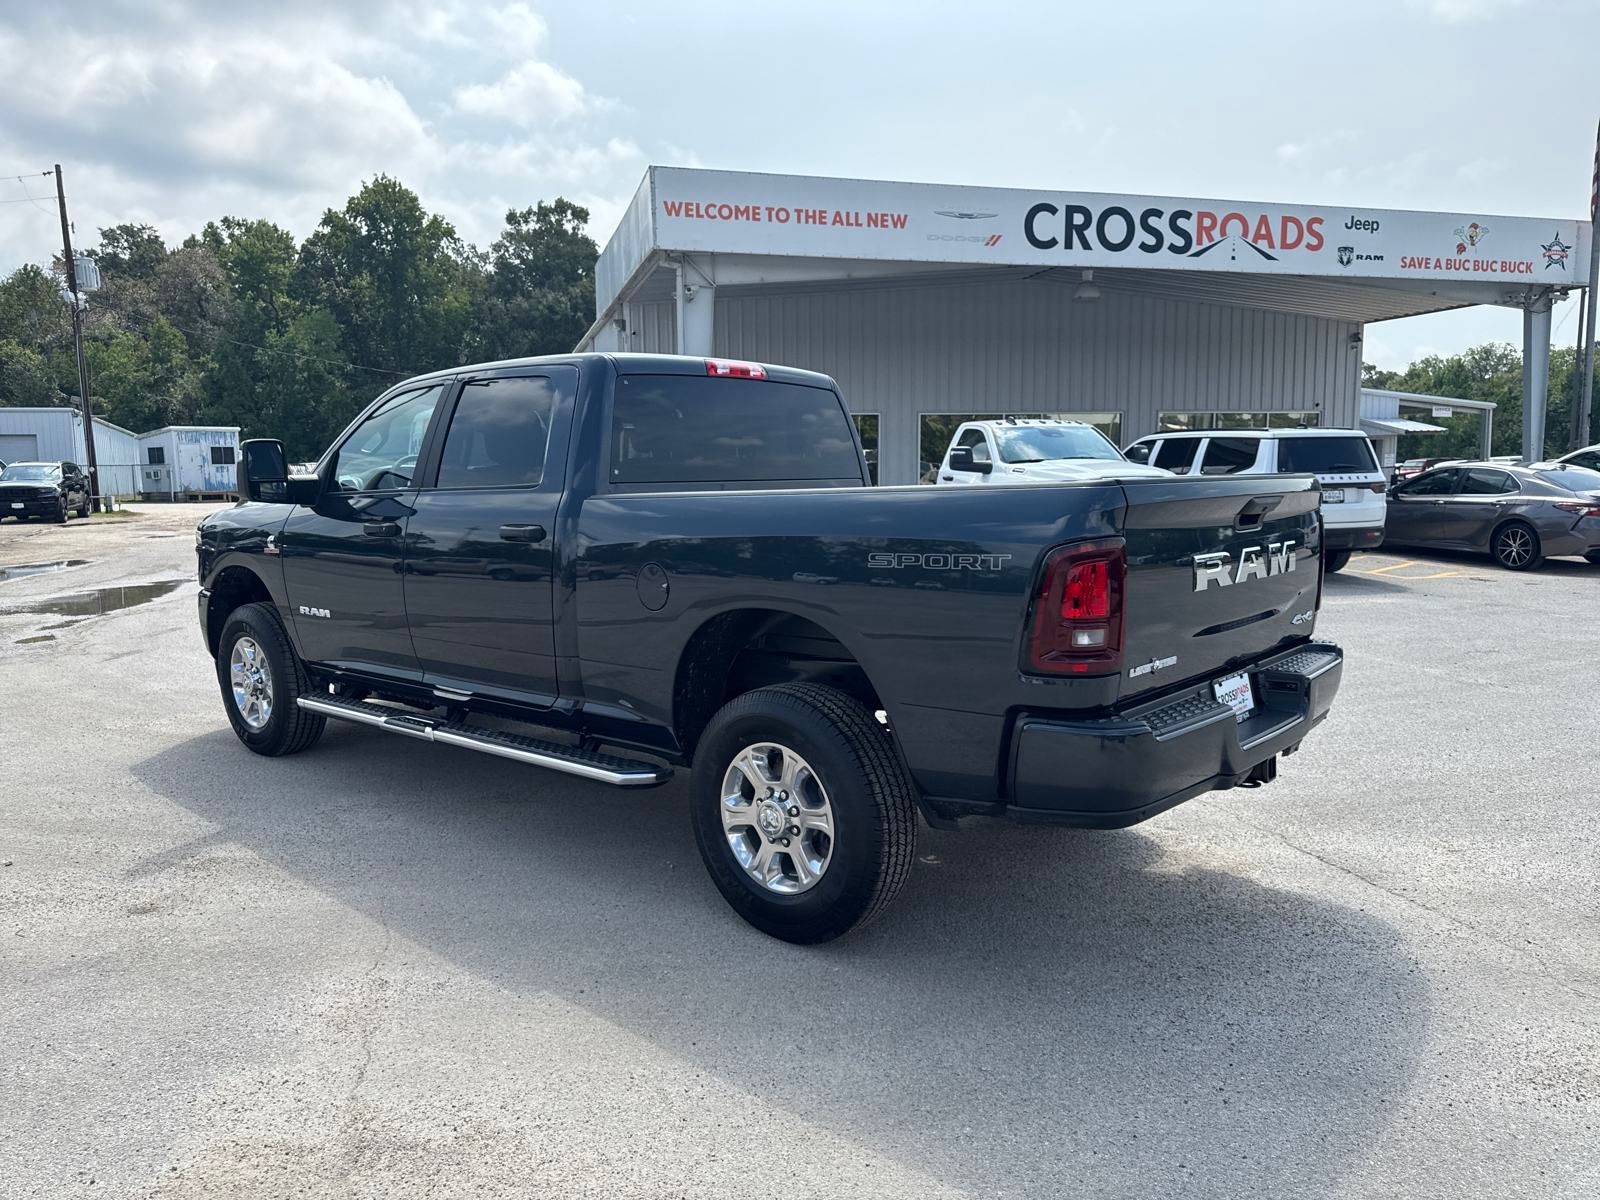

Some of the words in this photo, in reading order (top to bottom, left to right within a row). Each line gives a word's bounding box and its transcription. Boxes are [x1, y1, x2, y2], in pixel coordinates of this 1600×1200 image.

[663, 200, 761, 222] WELCOME
[765, 207, 790, 224] TO
[794, 208, 828, 226] THE
[831, 210, 863, 228] ALL
[866, 211, 909, 230] NEW
[1344, 215, 1380, 234] Jeep
[1023, 202, 1325, 255] CROSSROADS
[1356, 253, 1384, 262] RAM
[1400, 255, 1431, 270] SAVE
[1433, 257, 1443, 270] A
[1447, 258, 1470, 272] BUC
[1472, 259, 1498, 273] BUC
[1500, 260, 1534, 274] BUCK
[867, 552, 1012, 571] SPORT
[1191, 540, 1296, 592] RAM
[299, 605, 331, 618] RAM
